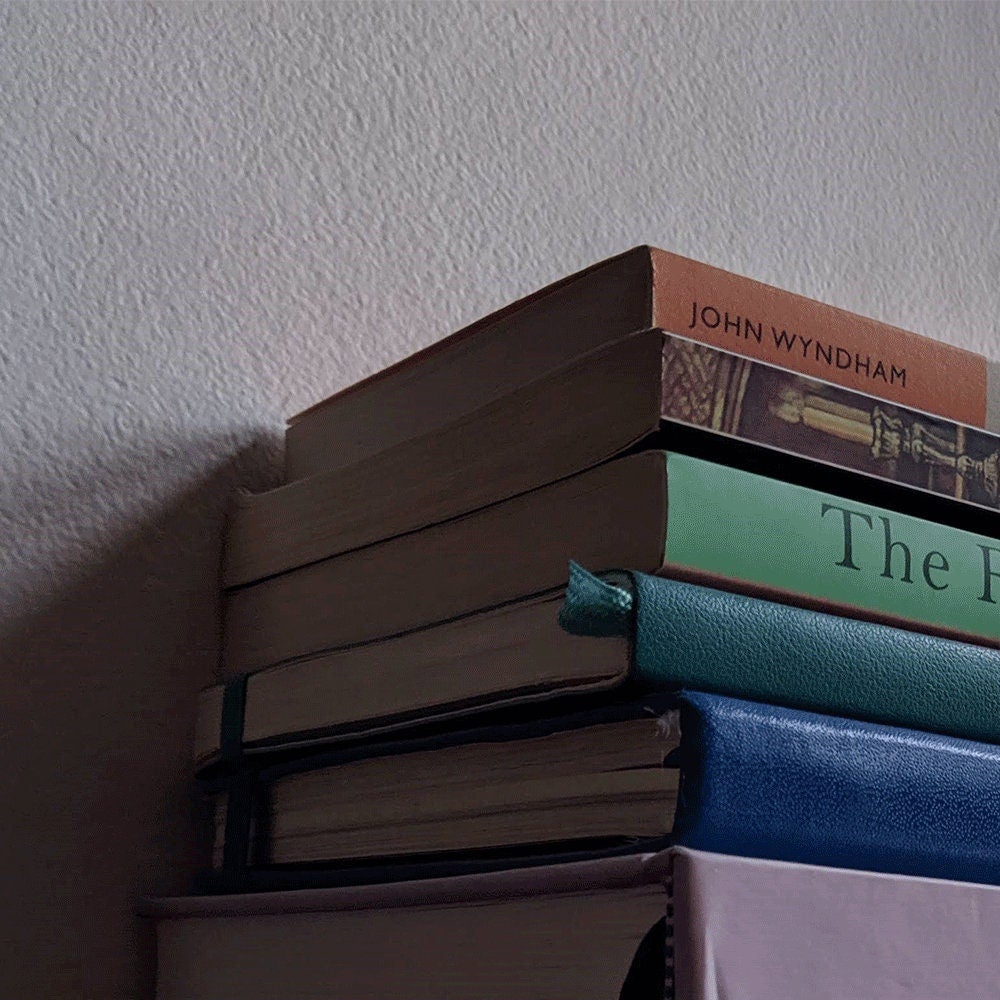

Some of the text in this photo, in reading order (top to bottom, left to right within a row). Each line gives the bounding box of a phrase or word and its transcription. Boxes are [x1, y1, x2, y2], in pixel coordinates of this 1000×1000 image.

[689, 302, 908, 389] JOHN WYNDHAM
[820, 502, 951, 592] The
